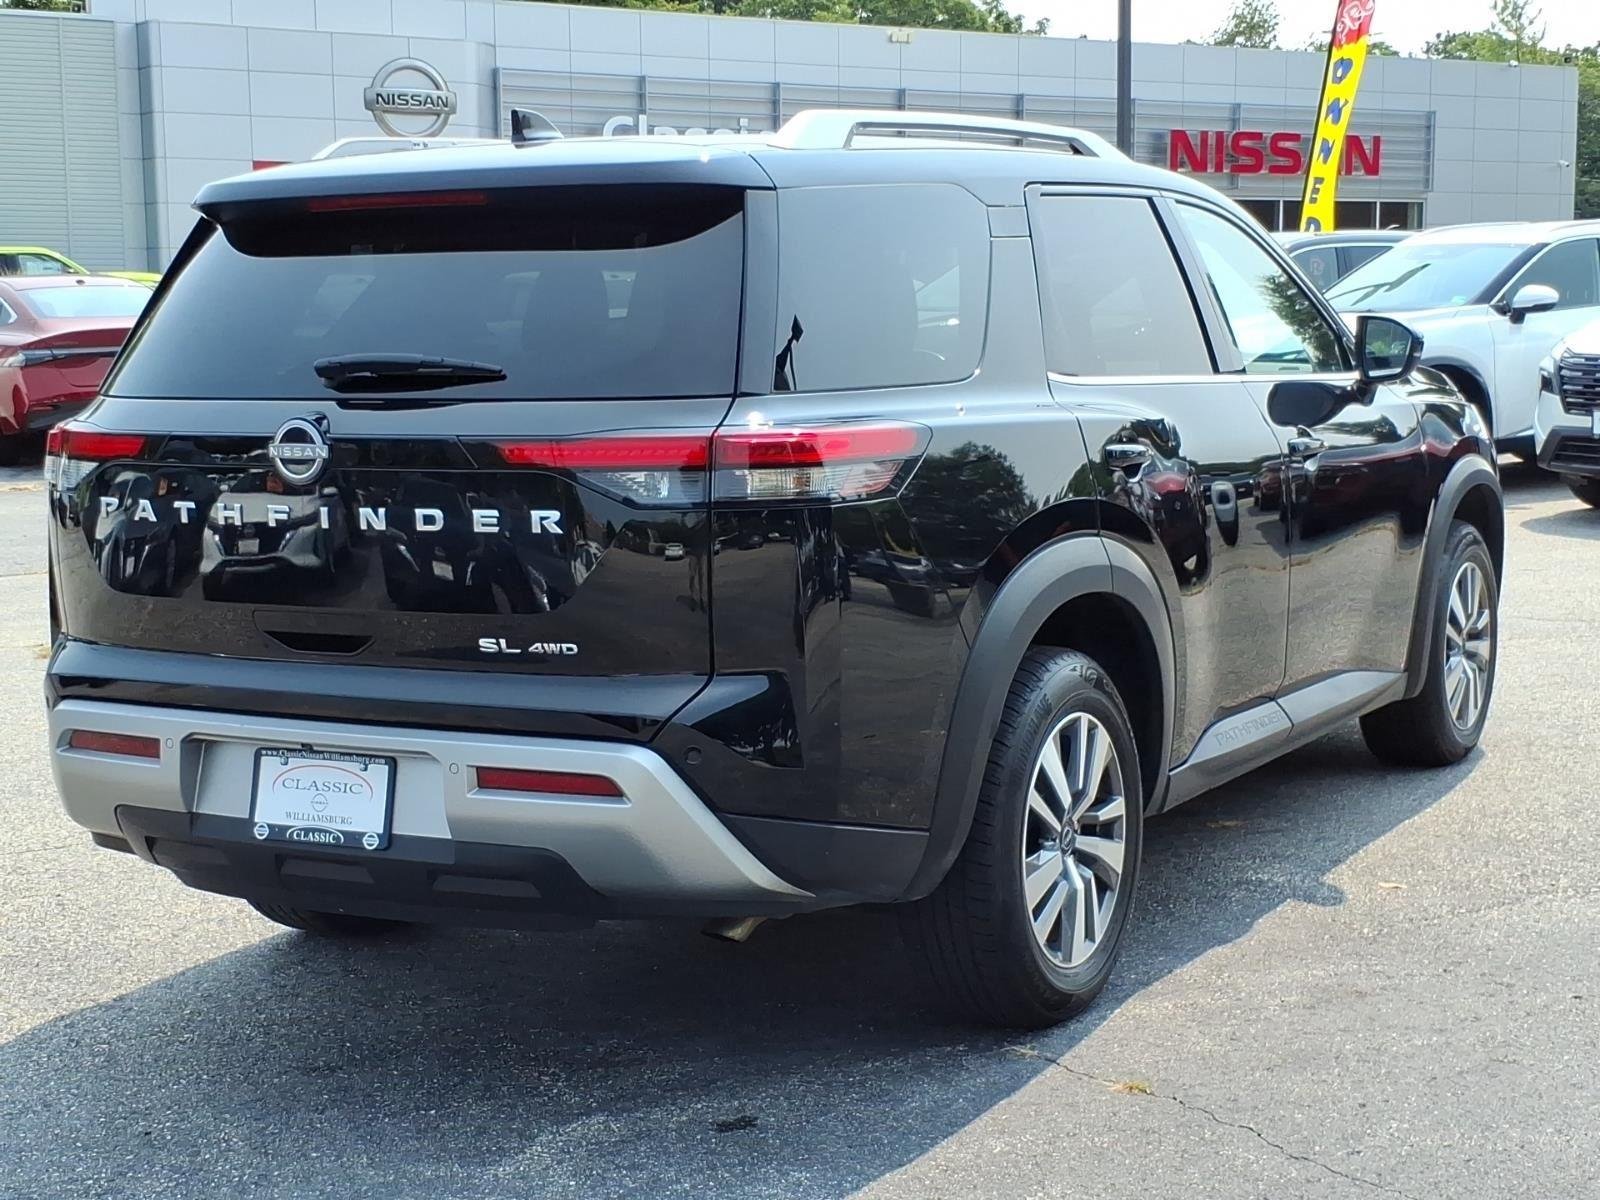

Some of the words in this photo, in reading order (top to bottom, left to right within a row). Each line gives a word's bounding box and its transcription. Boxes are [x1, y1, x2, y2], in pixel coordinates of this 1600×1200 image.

[375, 93, 449, 108] NISSAN
[1170, 129, 1381, 176] NISSN
[269, 446, 327, 458] NISSAN
[99, 496, 563, 534] PATHFINDER
[478, 638, 522, 654] SL
[528, 643, 578, 655] 4WD
[1214, 710, 1284, 746] PATHFINDER
[282, 778, 364, 795] CLASSIC
[285, 811, 353, 826] WILLIAMSBURG
[293, 830, 338, 844] CLASSIC
